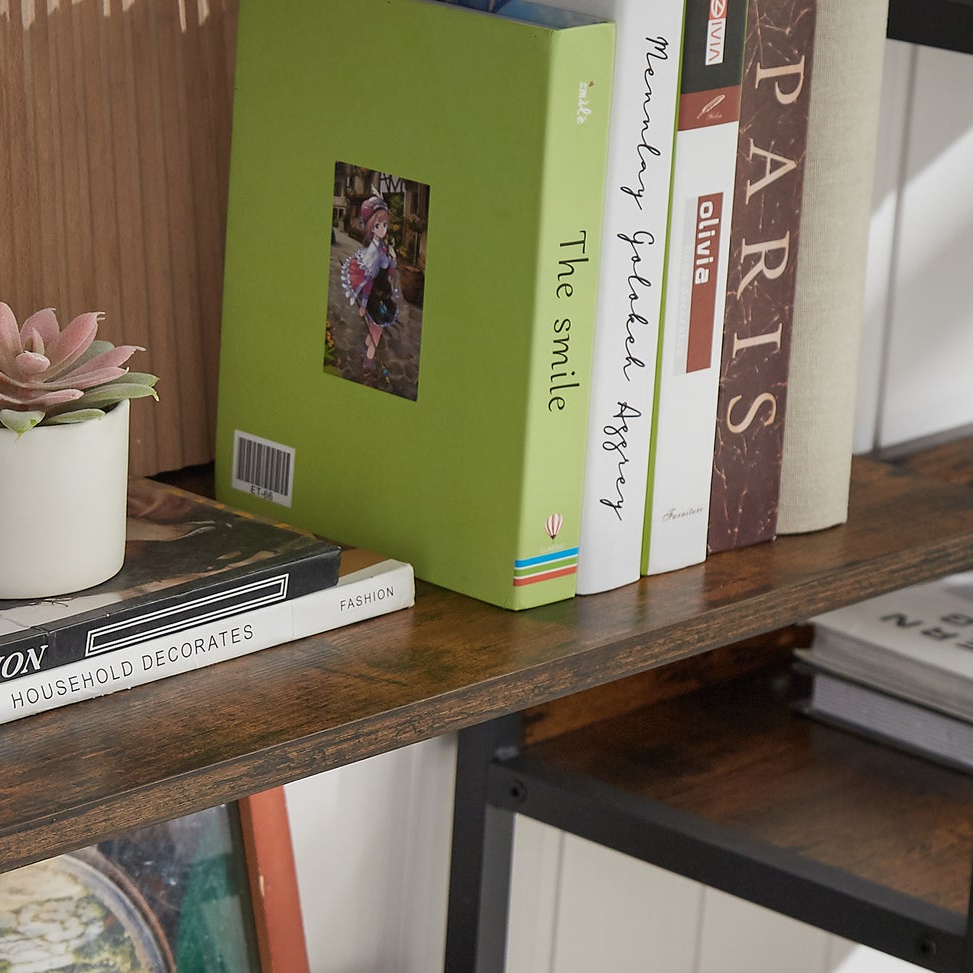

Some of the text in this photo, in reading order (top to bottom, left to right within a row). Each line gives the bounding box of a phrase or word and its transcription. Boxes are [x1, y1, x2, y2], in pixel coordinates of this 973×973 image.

[694, 200, 720, 285] olivia
[727, 55, 806, 434] PARIS
[548, 230, 589, 412] The smile
[340, 586, 394, 611] FASHION
[10, 624, 255, 709] HOUSEHOLD DECORATES
